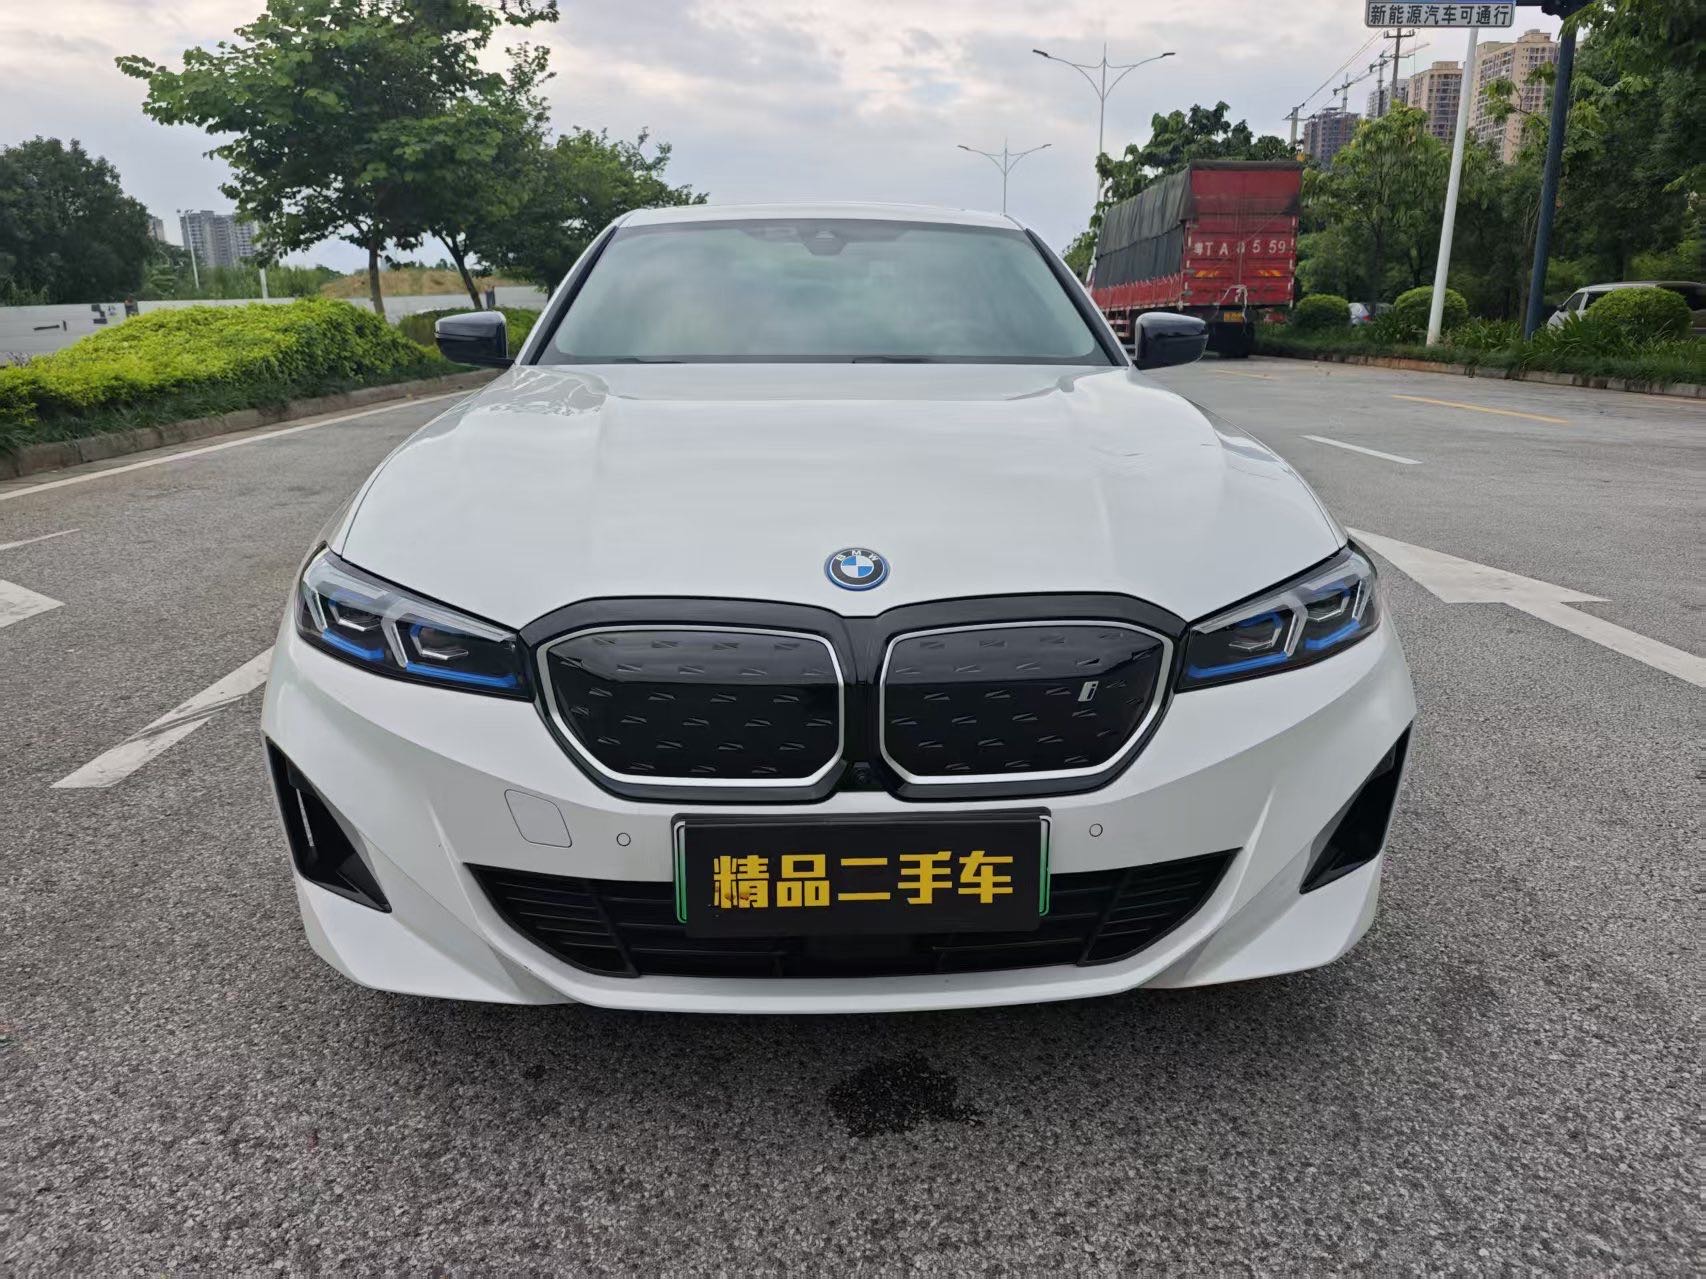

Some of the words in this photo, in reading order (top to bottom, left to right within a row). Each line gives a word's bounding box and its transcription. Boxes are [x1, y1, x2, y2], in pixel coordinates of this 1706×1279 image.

[1370, 5, 1510, 25] 新能源汽车可通行
[713, 850, 1014, 909] 精品二手车
